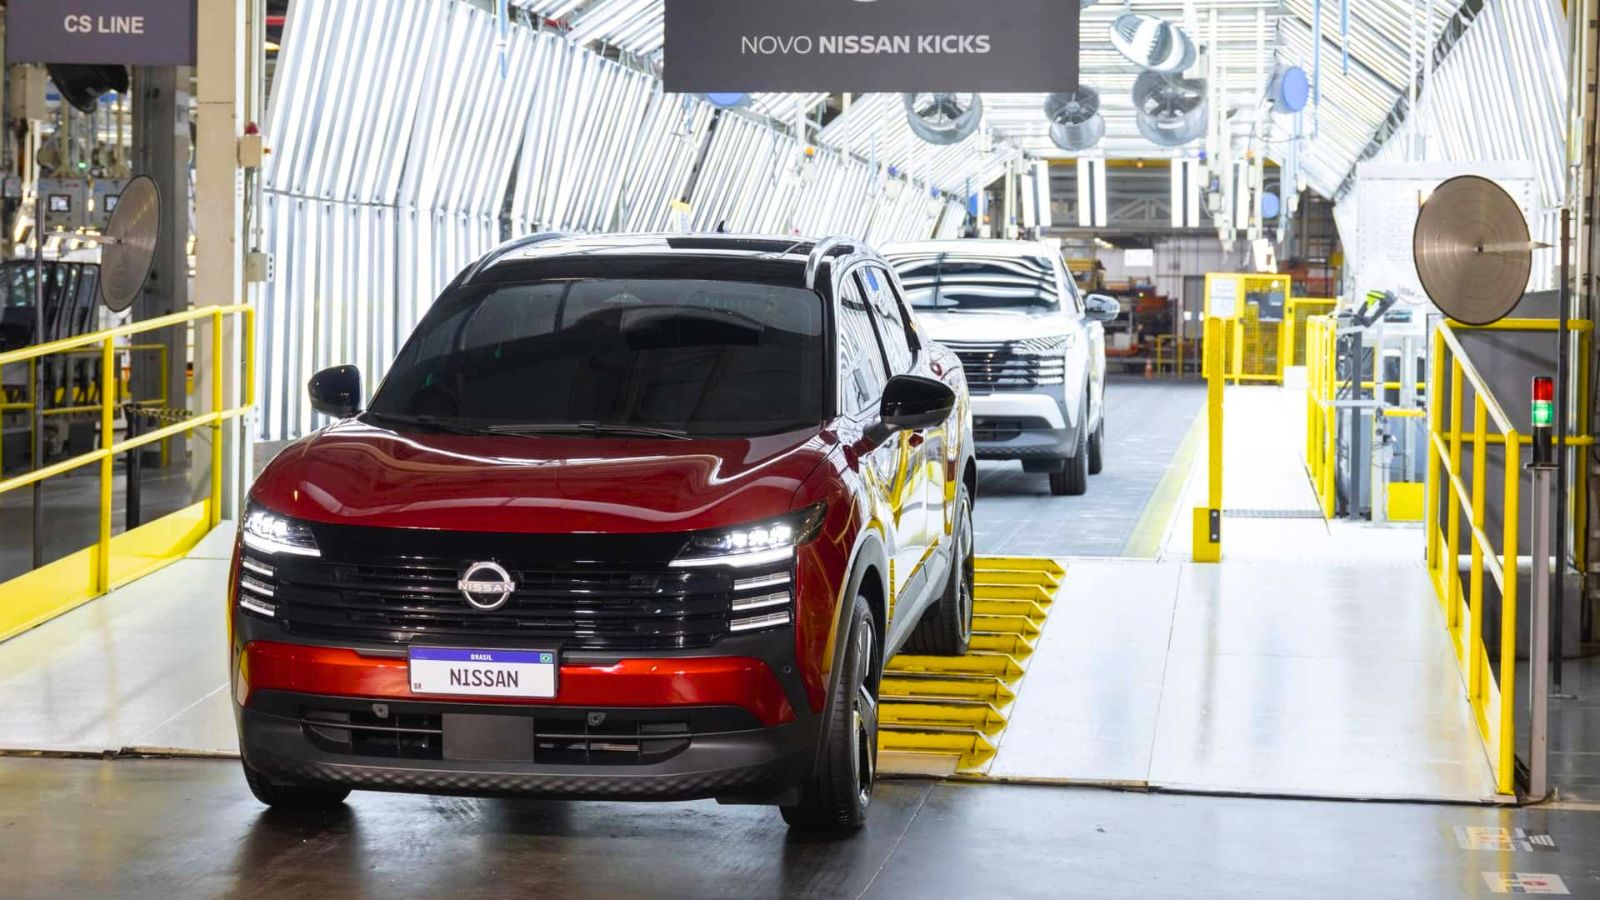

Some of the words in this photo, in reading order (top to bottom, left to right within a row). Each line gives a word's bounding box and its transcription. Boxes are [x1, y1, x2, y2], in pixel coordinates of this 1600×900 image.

[64, 15, 92, 32] CS
[98, 16, 144, 33] LINE
[741, 35, 812, 54] NOVO
[819, 35, 910, 54] NISSAN
[917, 34, 991, 53] KICKS
[458, 580, 514, 592] NISSAN
[470, 653, 493, 661] BRASIL
[450, 668, 519, 688] NISSAN
